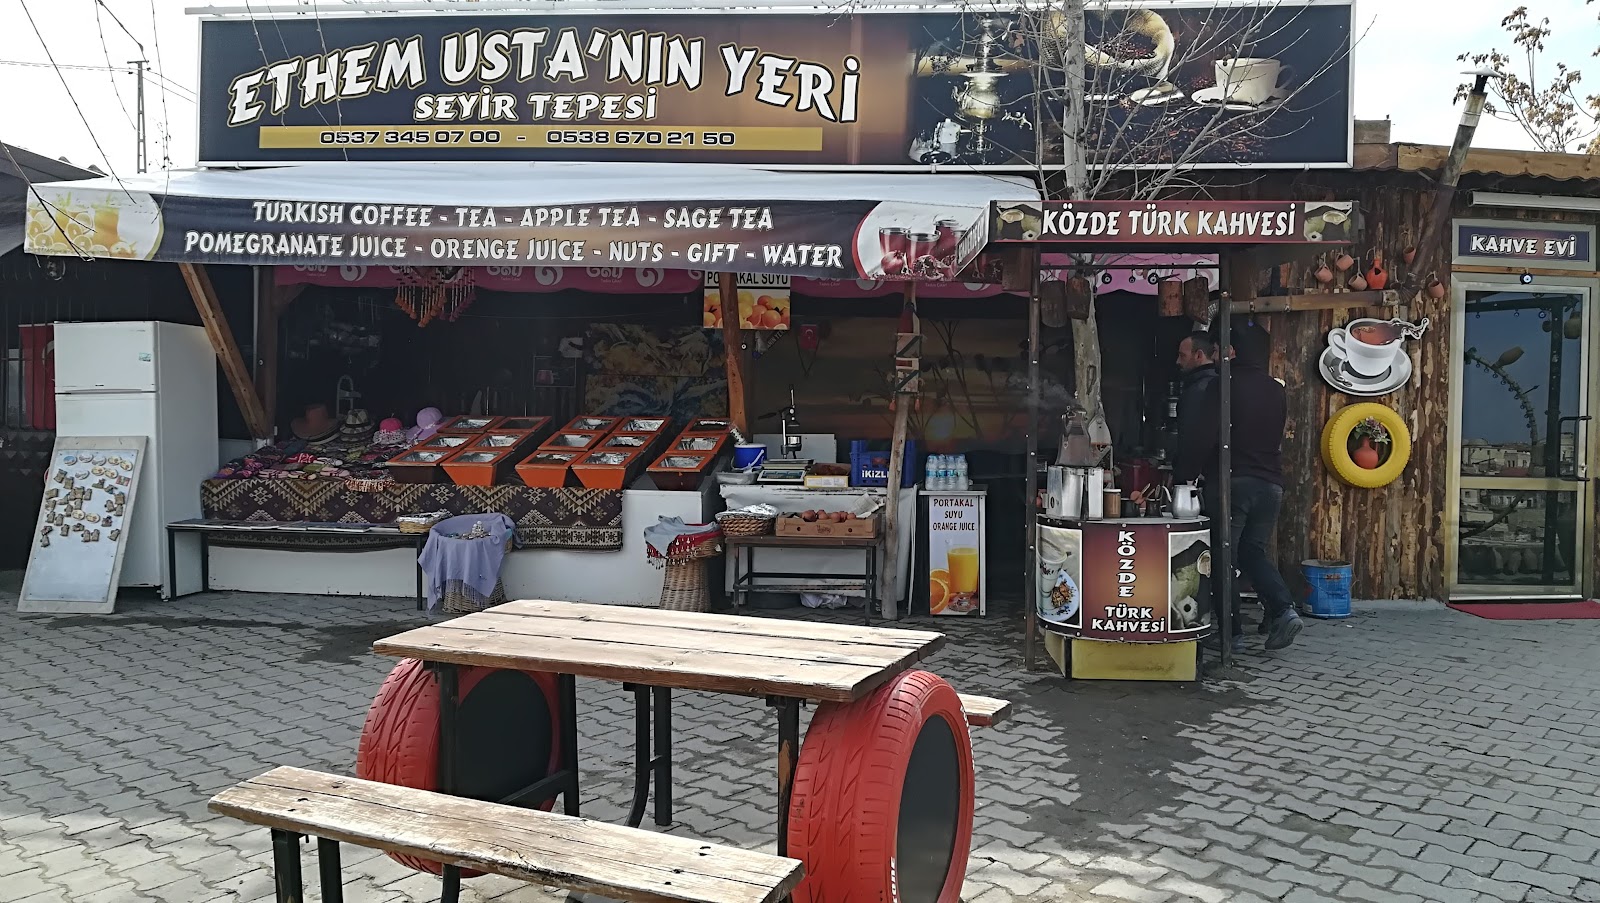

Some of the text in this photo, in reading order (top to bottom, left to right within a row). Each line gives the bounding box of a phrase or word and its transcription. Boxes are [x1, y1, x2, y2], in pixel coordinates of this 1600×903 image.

[229, 28, 859, 125] ETHEM USTA'NIN YERİ
[414, 87, 656, 120] SEYİR TEPESİ
[320, 131, 379, 144] 0537
[385, 131, 430, 144] 345
[435, 131, 464, 144] 07
[469, 131, 501, 144] 00
[547, 131, 609, 145] 0538
[615, 131, 662, 145] 670
[667, 131, 695, 145] 21
[702, 131, 735, 145] 50
[253, 201, 344, 224] TURKISH
[350, 205, 432, 227] COFFEE
[455, 207, 497, 228] TEA
[519, 207, 591, 227] APPLE
[598, 207, 640, 228] TEA
[663, 208, 721, 229] SAGE
[729, 207, 774, 230] TEA
[1041, 202, 1296, 236] KÖZDE TÜRK KAHVESİ
[184, 231, 345, 256] POMEGRANATE
[350, 236, 407, 258] JUICE
[430, 237, 519, 260] ORENGE
[526, 238, 585, 262] JUICE
[609, 240, 663, 263] NUTS
[687, 242, 741, 264] GIFT
[763, 244, 843, 268] WATER
[1471, 235, 1575, 256] KAHVE EVİ
[761, 273, 788, 285] SUYU
[933, 498, 974, 507] PORTAKAL
[944, 510, 963, 519] SUYU
[932, 522, 975, 531] ORANGE JUICE
[1117, 530, 1137, 597] KÖZDE
[1104, 603, 1152, 619] TÜRK
[1091, 617, 1166, 633] KAHVESİ
